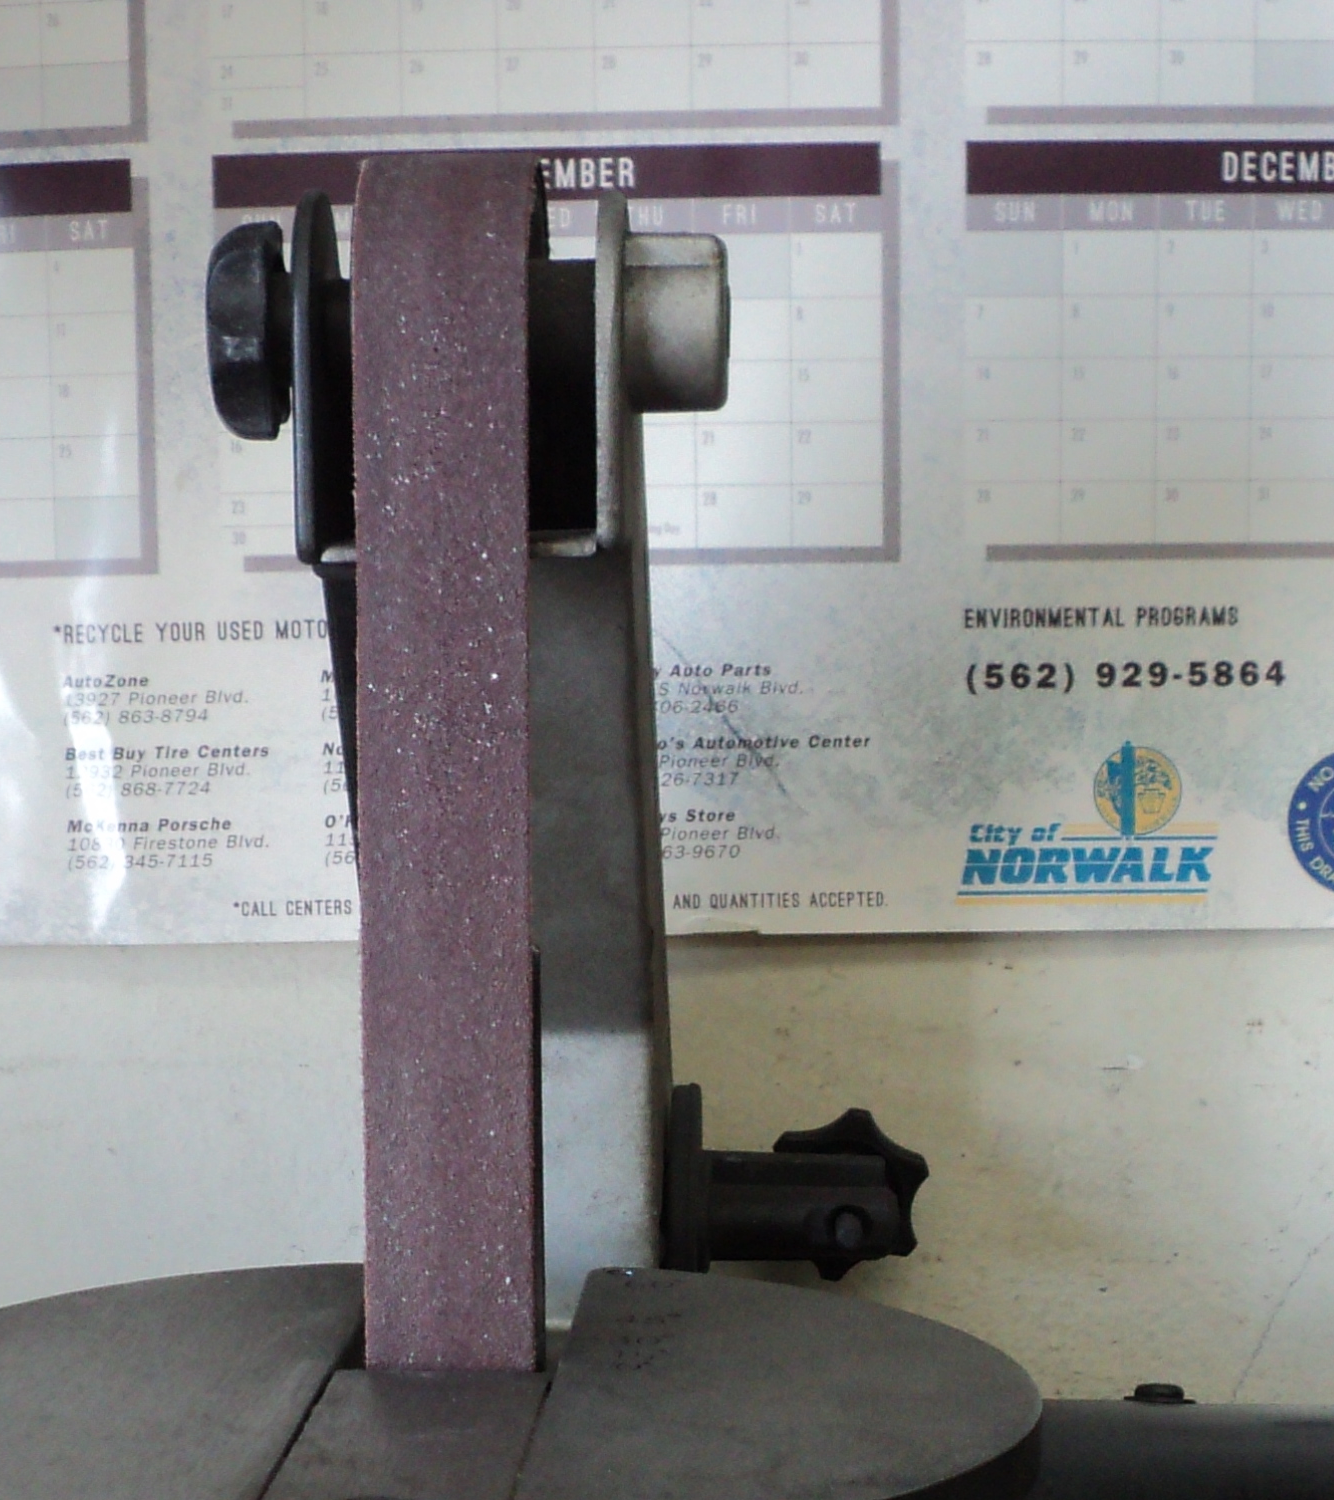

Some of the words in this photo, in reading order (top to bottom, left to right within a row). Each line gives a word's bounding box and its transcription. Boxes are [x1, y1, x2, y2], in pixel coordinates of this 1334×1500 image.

[722, 204, 758, 225] FRI
[814, 202, 857, 224] SAT
[993, 201, 1037, 224] SUN
[1089, 201, 1134, 224] MON
[1185, 200, 1226, 223] TUE
[1278, 200, 1324, 223] WED
[69, 219, 109, 242] SAT
[964, 606, 1125, 629] ENVIRONMENTAL
[1136, 605, 1240, 628] PROGRAMS
[155, 621, 206, 642] YOUR
[217, 620, 264, 641] USED
[669, 664, 714, 678] Auto
[720, 663, 773, 678] Parts
[966, 662, 1076, 695] (562)
[1095, 659, 1287, 689] 929-5864
[63, 674, 150, 689] AutoZone
[678, 682, 752, 697] Norwalk
[759, 681, 805, 696] Blvd.
[128, 690, 199, 706] Pioneer
[205, 689, 250, 704] Blvd.
[118, 708, 209, 725] 863-8794
[693, 735, 800, 751] Automotive
[808, 735, 871, 750] Center
[113, 746, 147, 764] Buy
[155, 745, 190, 761] Tire
[197, 744, 270, 759] Centers
[659, 754, 729, 769] Pioneer
[736, 753, 781, 769] Blvd.
[130, 763, 201, 779] Pioneer
[207, 762, 252, 778] Blvd.
[121, 780, 212, 797] 868-7724
[685, 809, 736, 823] Store
[158, 817, 233, 833] Porsche
[660, 826, 729, 842] Pioneer
[737, 825, 780, 841] Blvd.
[133, 835, 221, 851] Firestone
[226, 834, 271, 850] Blvd.
[969, 822, 1023, 846] City
[1030, 822, 1063, 843] of
[1295, 817, 1314, 853] THIS
[124, 853, 214, 869] 345-7115
[960, 845, 1215, 886] NORWALK
[285, 898, 353, 917] CENTERS
[673, 893, 701, 910] AND
[709, 892, 801, 910] QUANTITIES
[810, 891, 889, 908] ACCEPTED.
